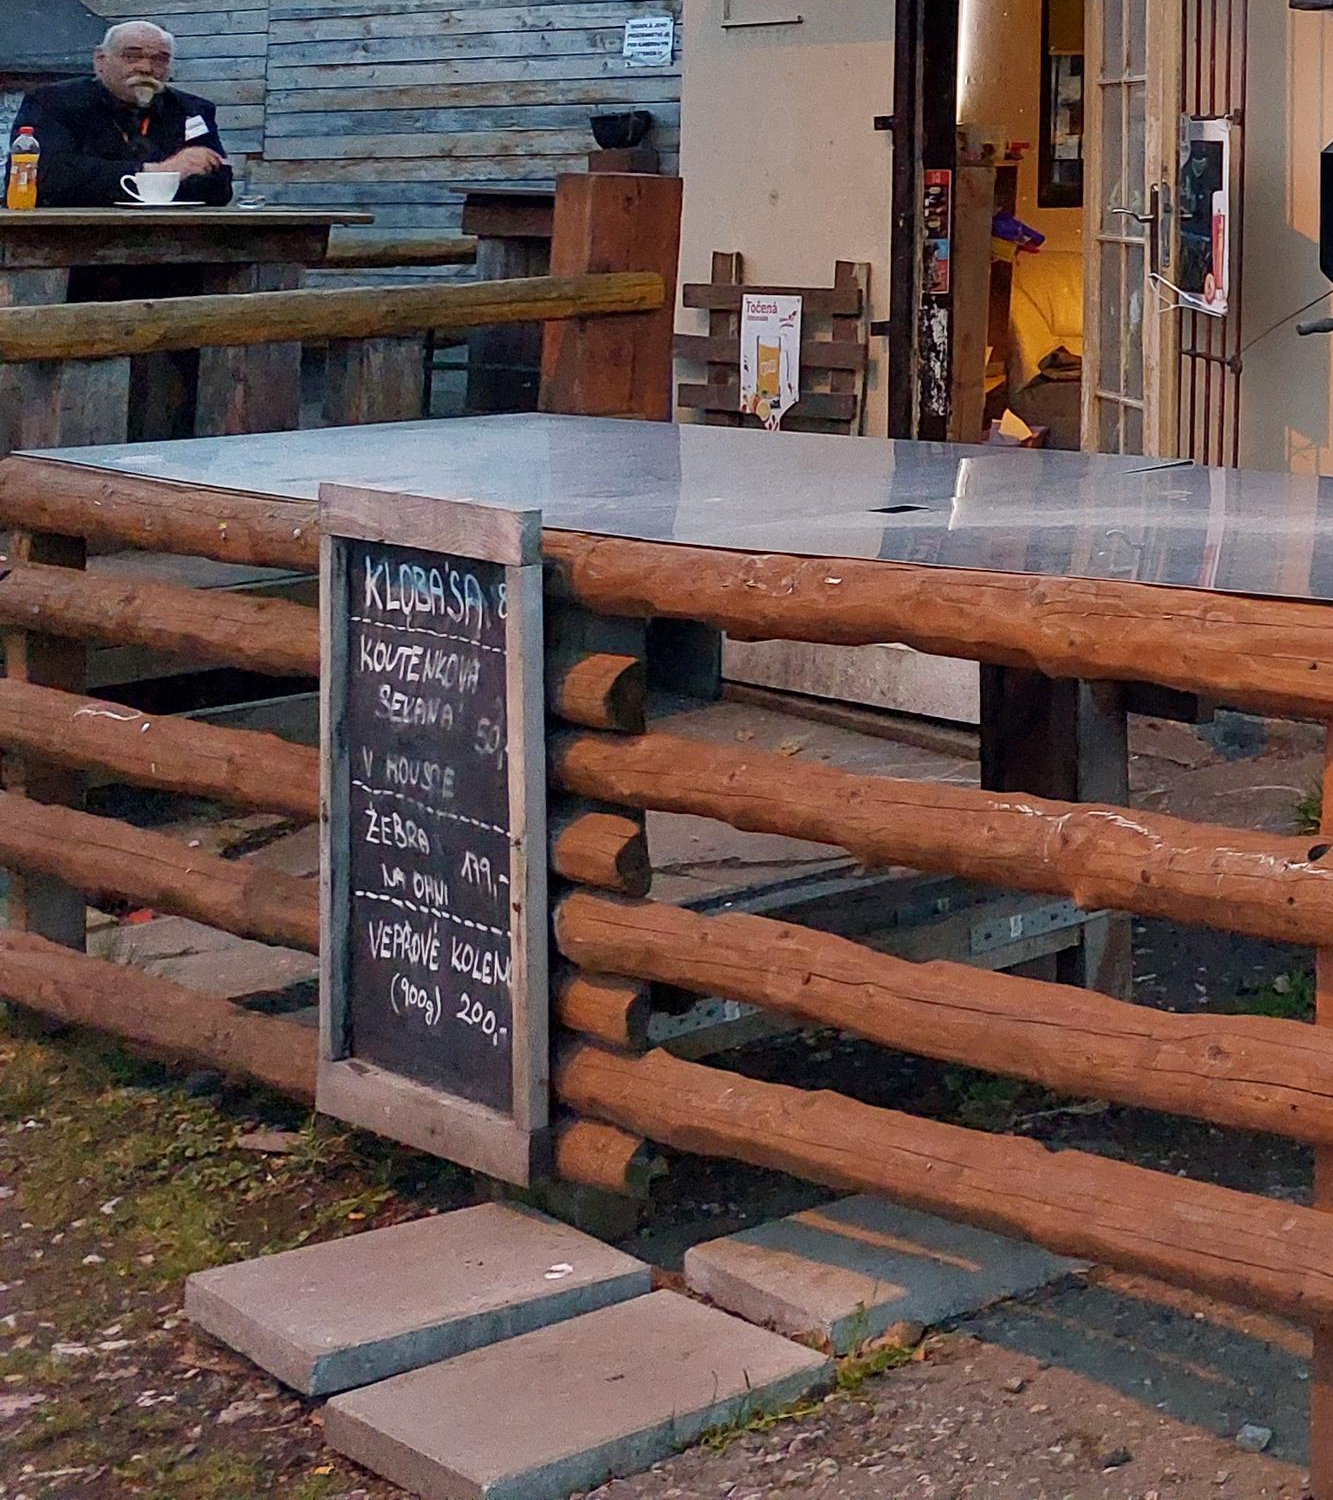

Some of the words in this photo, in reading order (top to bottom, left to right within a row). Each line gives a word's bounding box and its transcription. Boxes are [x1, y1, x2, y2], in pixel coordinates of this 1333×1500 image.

[746, 301, 778, 314] Točená
[363, 746, 373, 778] V
[381, 863, 405, 890] NA
[391, 972, 442, 1026] (900g)
